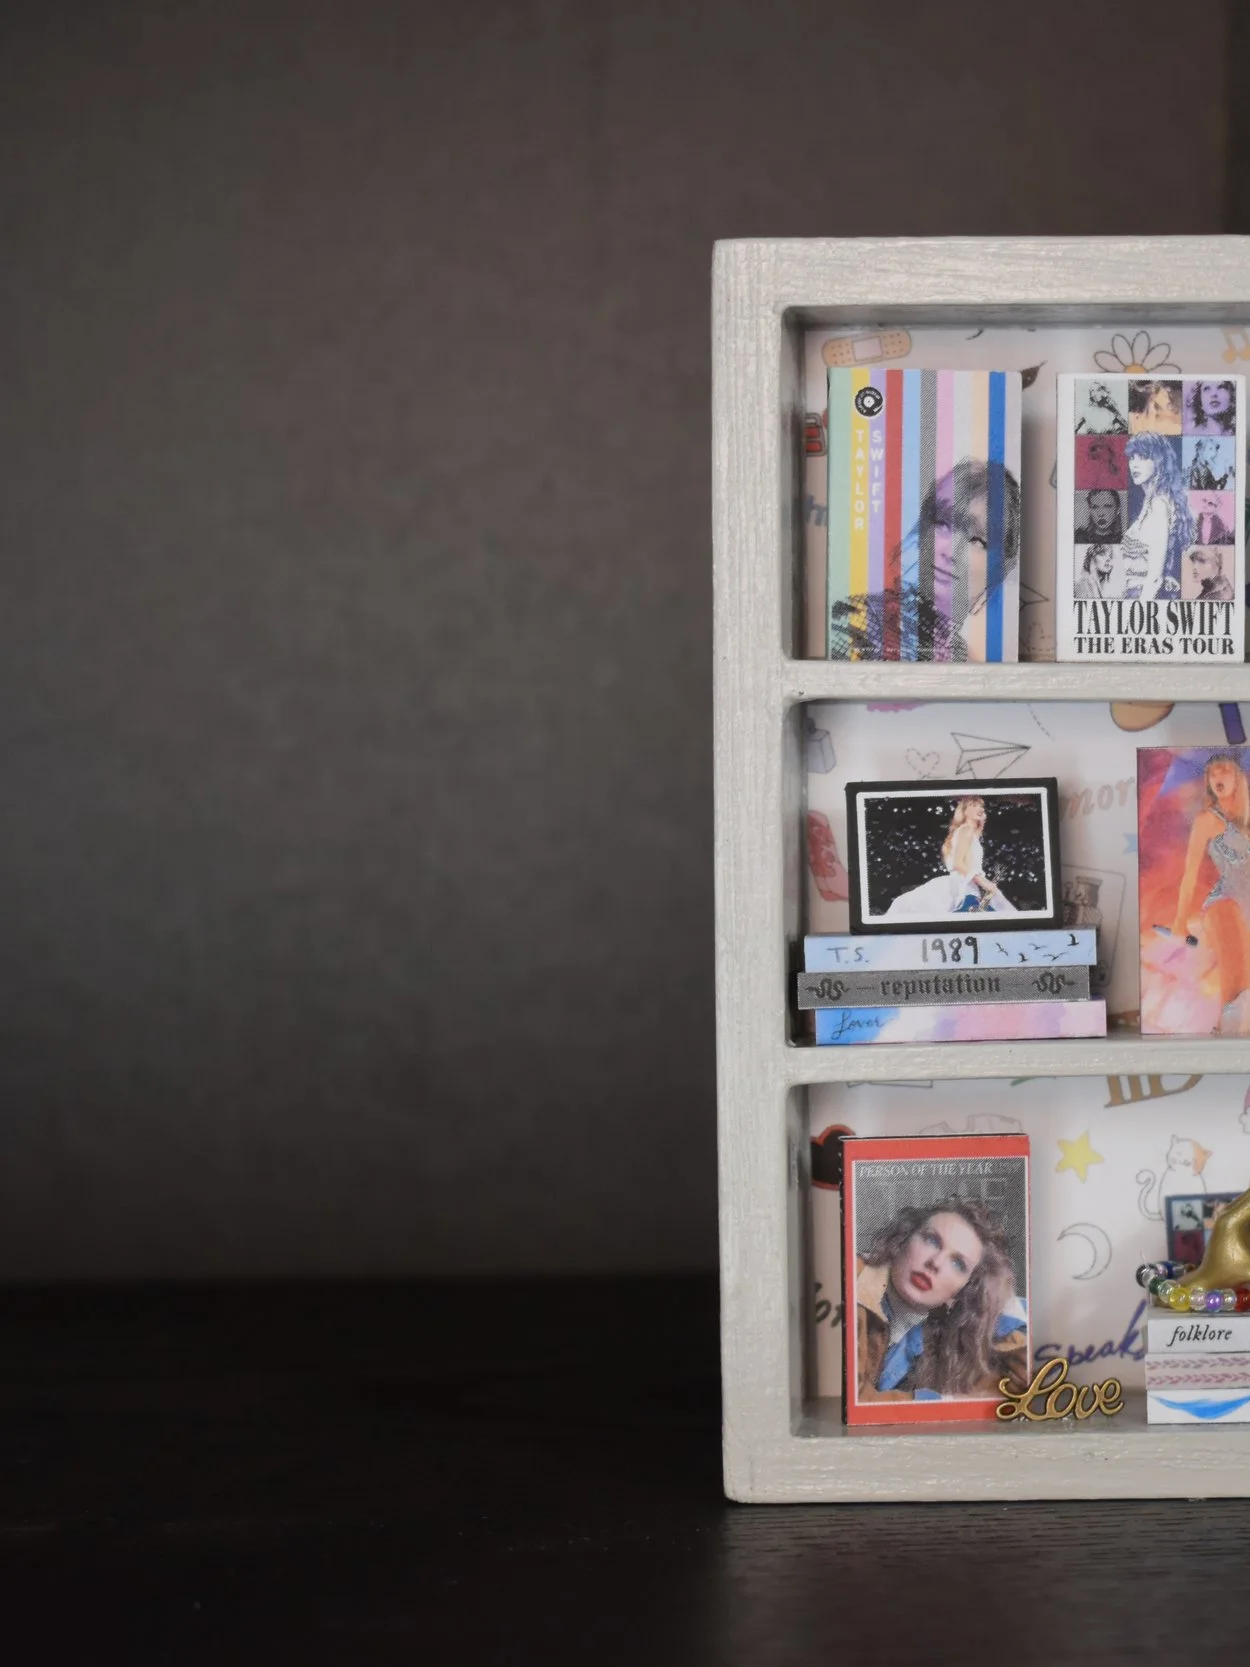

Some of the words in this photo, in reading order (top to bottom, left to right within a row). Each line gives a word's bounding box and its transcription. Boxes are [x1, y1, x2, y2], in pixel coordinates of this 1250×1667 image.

[855, 429, 866, 532] TAYLOR
[871, 430, 884, 514] SWIFT
[1073, 600, 1160, 635] TAYLOR
[1166, 600, 1235, 636] SWIFT
[1074, 637, 1115, 654] THE
[1121, 637, 1174, 655] ERAS
[1179, 637, 1235, 655] TOUR
[921, 936, 979, 965] 1989
[880, 974, 1001, 999] reputation
[831, 1012, 885, 1039] Lover
[859, 1164, 909, 1177] PERSON
[911, 1163, 929, 1176] OF
[931, 1162, 957, 1176] THE
[958, 1161, 993, 1176] YEAR
[1166, 1324, 1233, 1347] folklore
[996, 1358, 1125, 1422] Love
